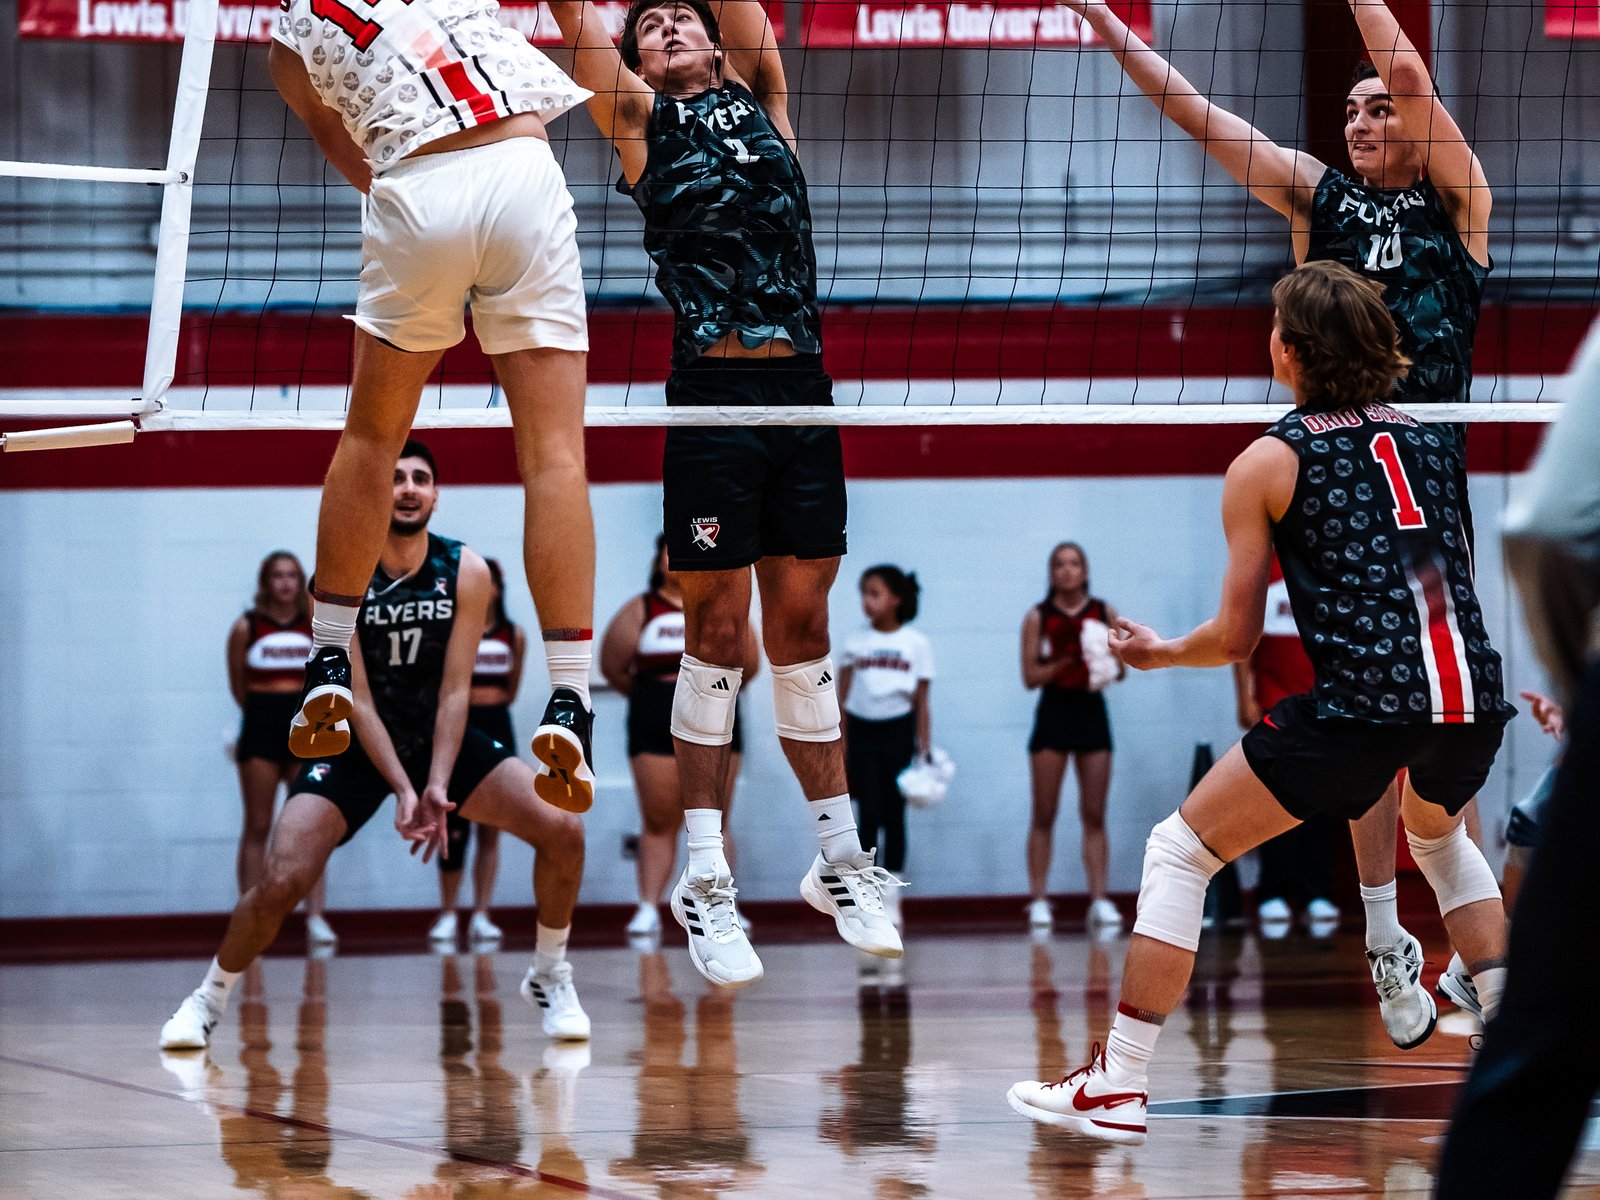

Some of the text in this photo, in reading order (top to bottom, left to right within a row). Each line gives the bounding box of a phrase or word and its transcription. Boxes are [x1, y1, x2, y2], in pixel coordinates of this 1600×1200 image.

[857, 2, 943, 41] Lewis
[1364, 222, 1403, 271] 10
[1369, 432, 1428, 530] 1
[692, 516, 718, 524] LEWIS
[365, 600, 453, 626] FLYERS
[388, 627, 422, 666] 17
